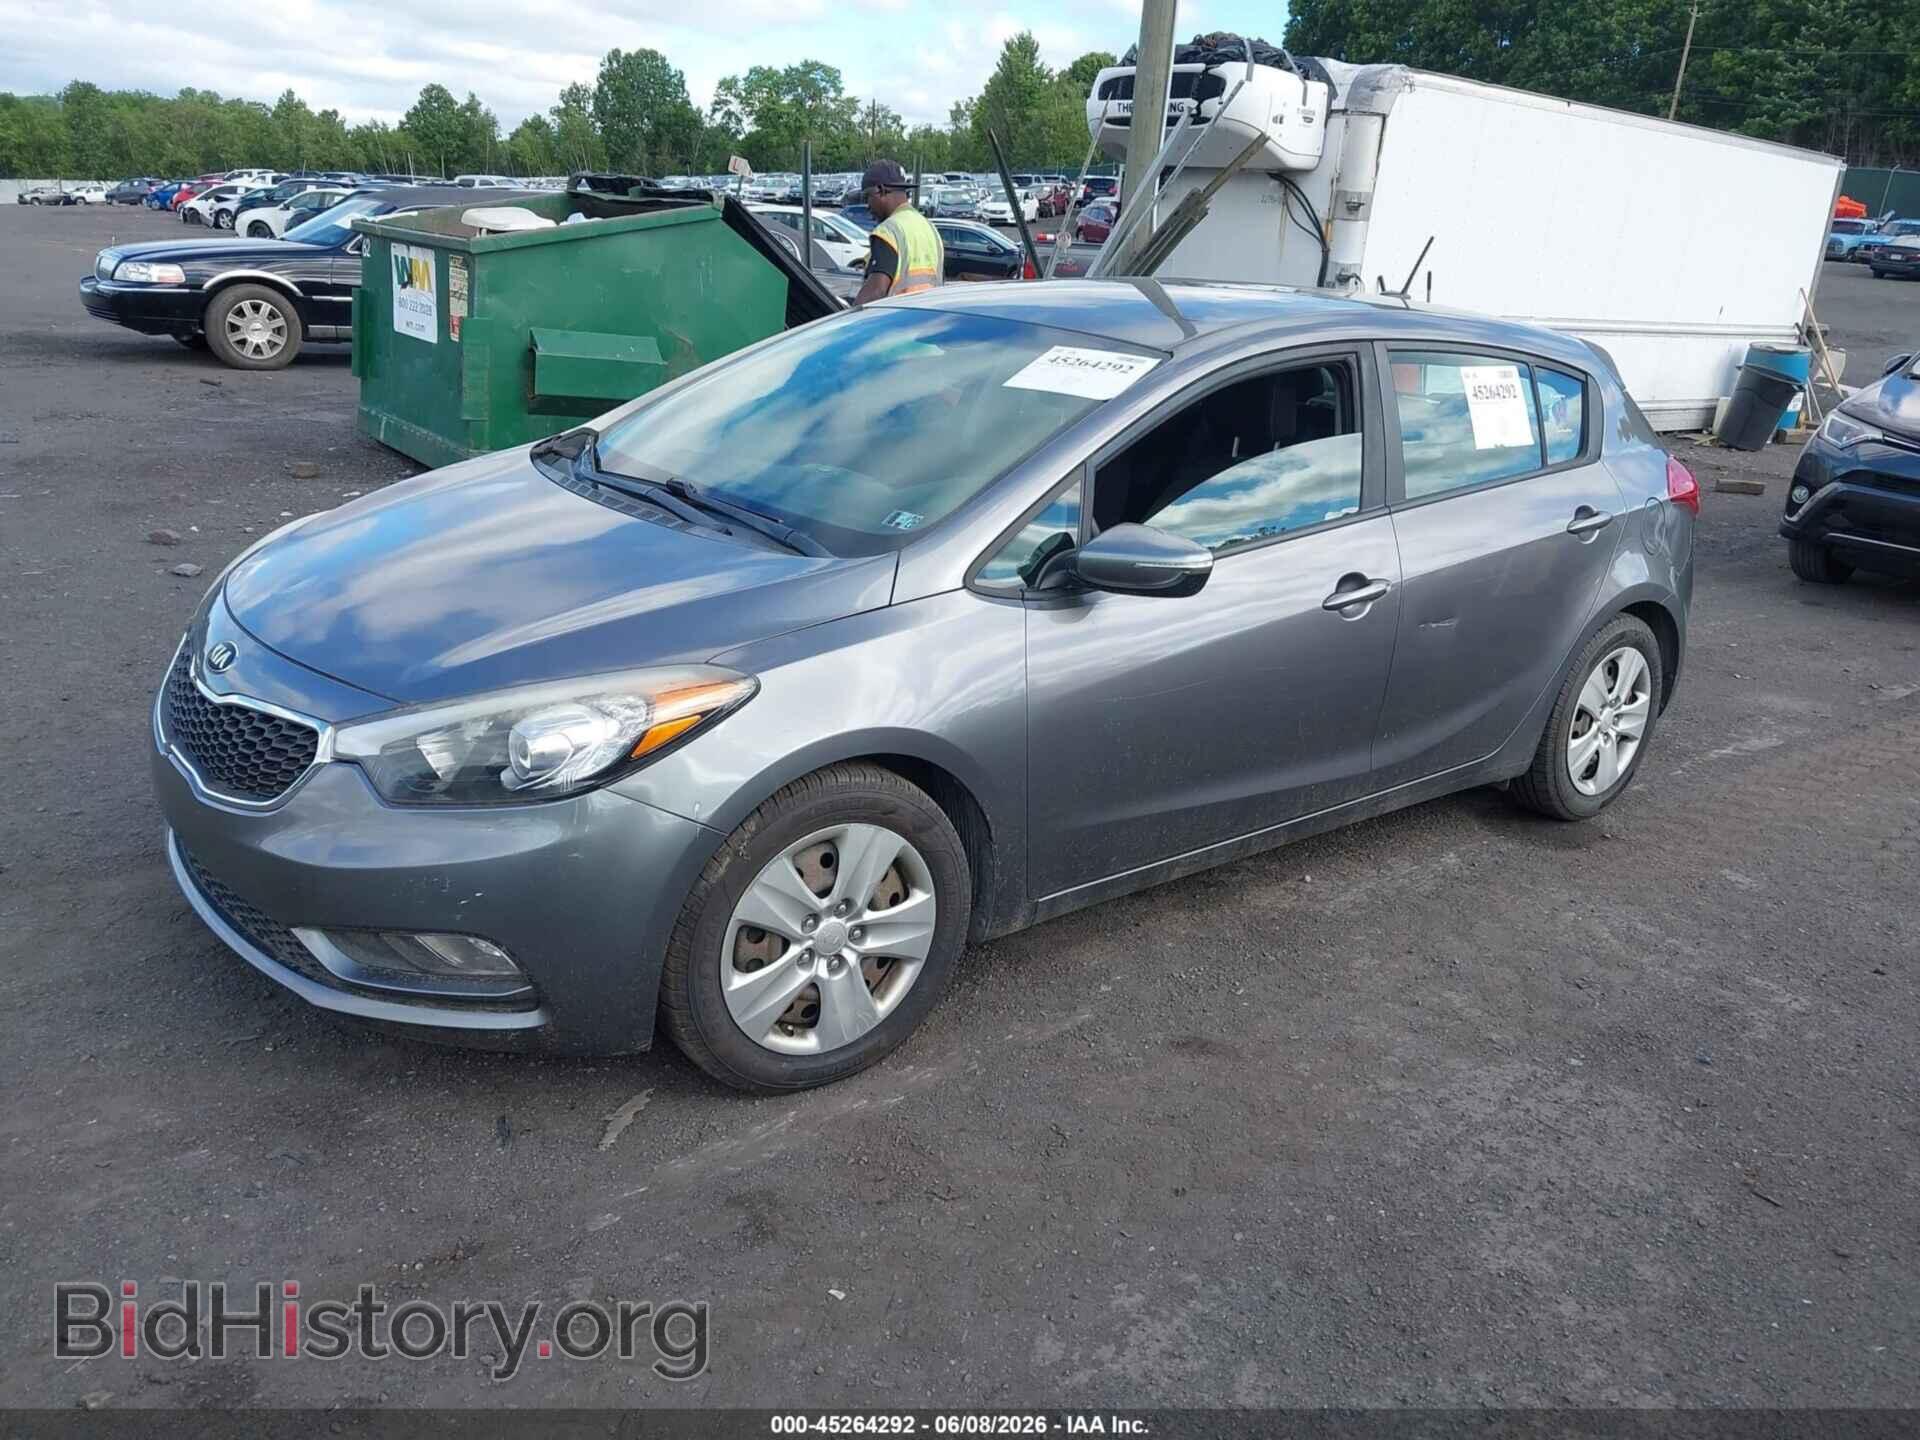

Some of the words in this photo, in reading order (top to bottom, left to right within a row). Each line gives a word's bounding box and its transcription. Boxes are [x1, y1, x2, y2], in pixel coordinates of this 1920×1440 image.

[393, 254, 432, 291] WM
[1047, 355, 1135, 375] 45264292
[1472, 384, 1518, 400] 45264292
